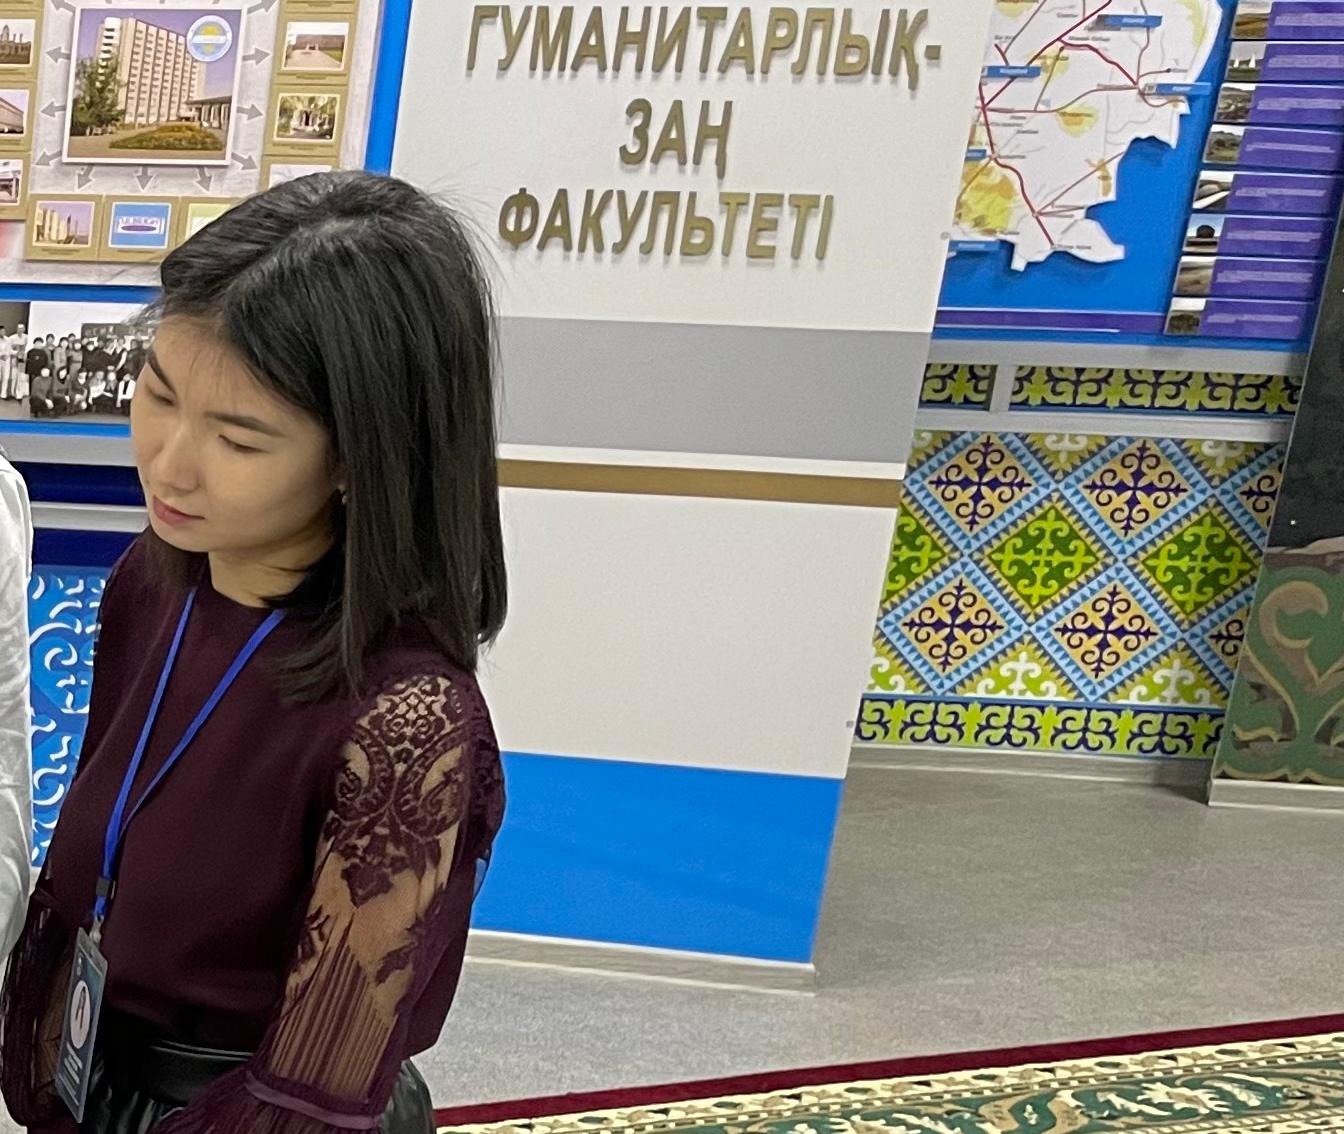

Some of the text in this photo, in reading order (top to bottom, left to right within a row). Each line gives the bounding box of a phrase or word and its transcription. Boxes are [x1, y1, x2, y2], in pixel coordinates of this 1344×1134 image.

[465, 5, 942, 91] ГУМАНИТАРЛЫҚ-
[619, 98, 733, 179] ЗАҢ
[498, 188, 834, 261] ФАКУЛЬТЕТІ
